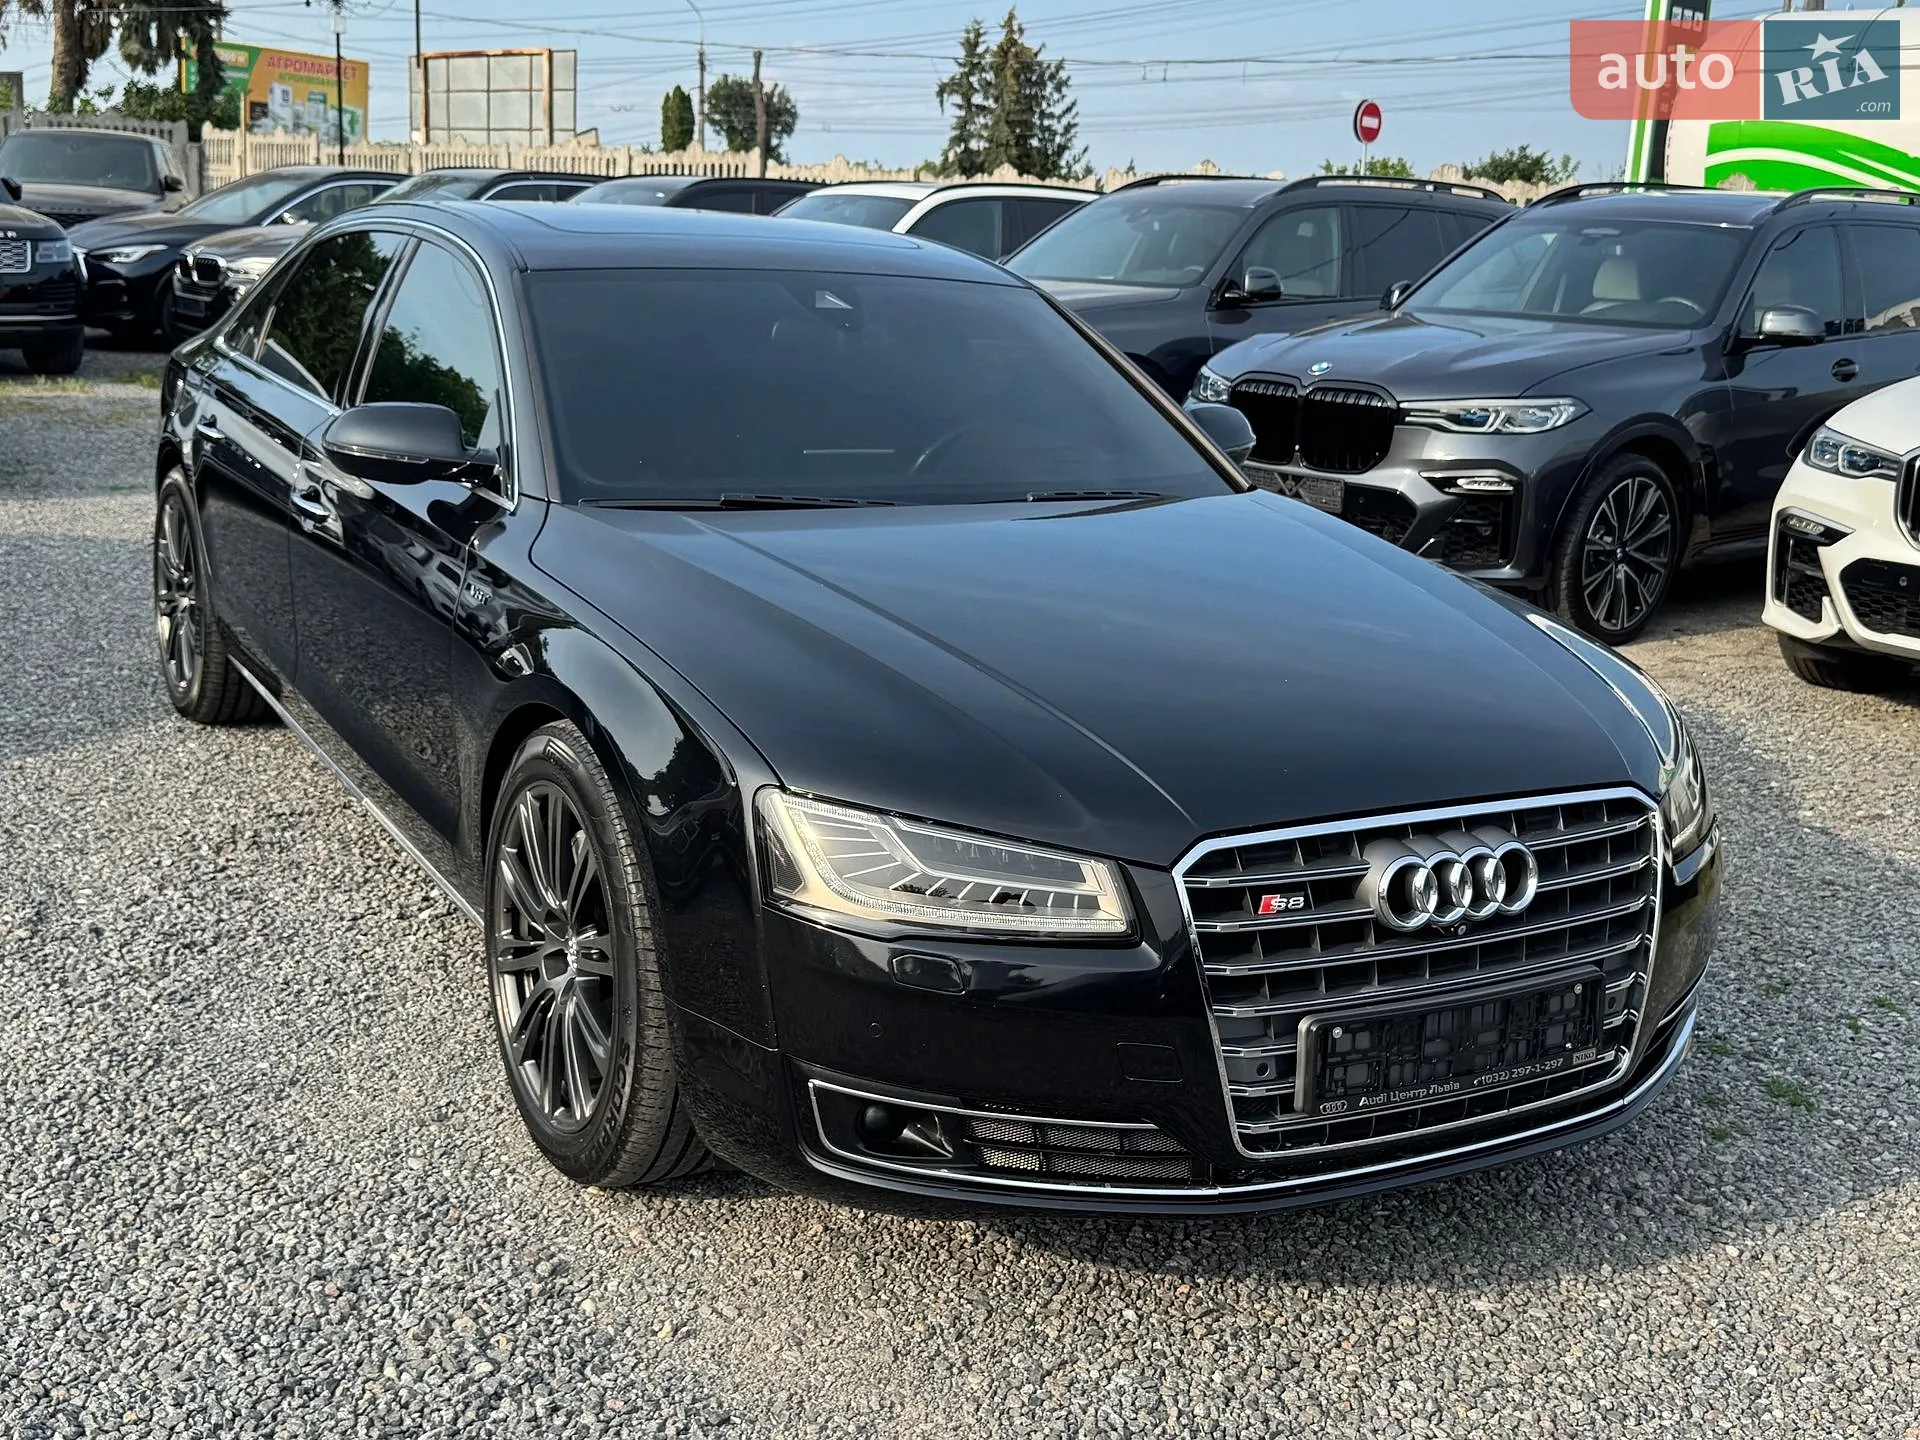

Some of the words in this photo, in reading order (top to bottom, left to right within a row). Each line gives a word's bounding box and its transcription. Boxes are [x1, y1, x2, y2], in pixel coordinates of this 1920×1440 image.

[1270, 896, 1305, 911] S8
[1573, 1050, 1596, 1063] NIKO
[1358, 1093, 1388, 1107] Audi
[1389, 1088, 1428, 1102] Центр
[1428, 1081, 1461, 1095] Львів
[1511, 1058, 1564, 1078] 297-1-297
